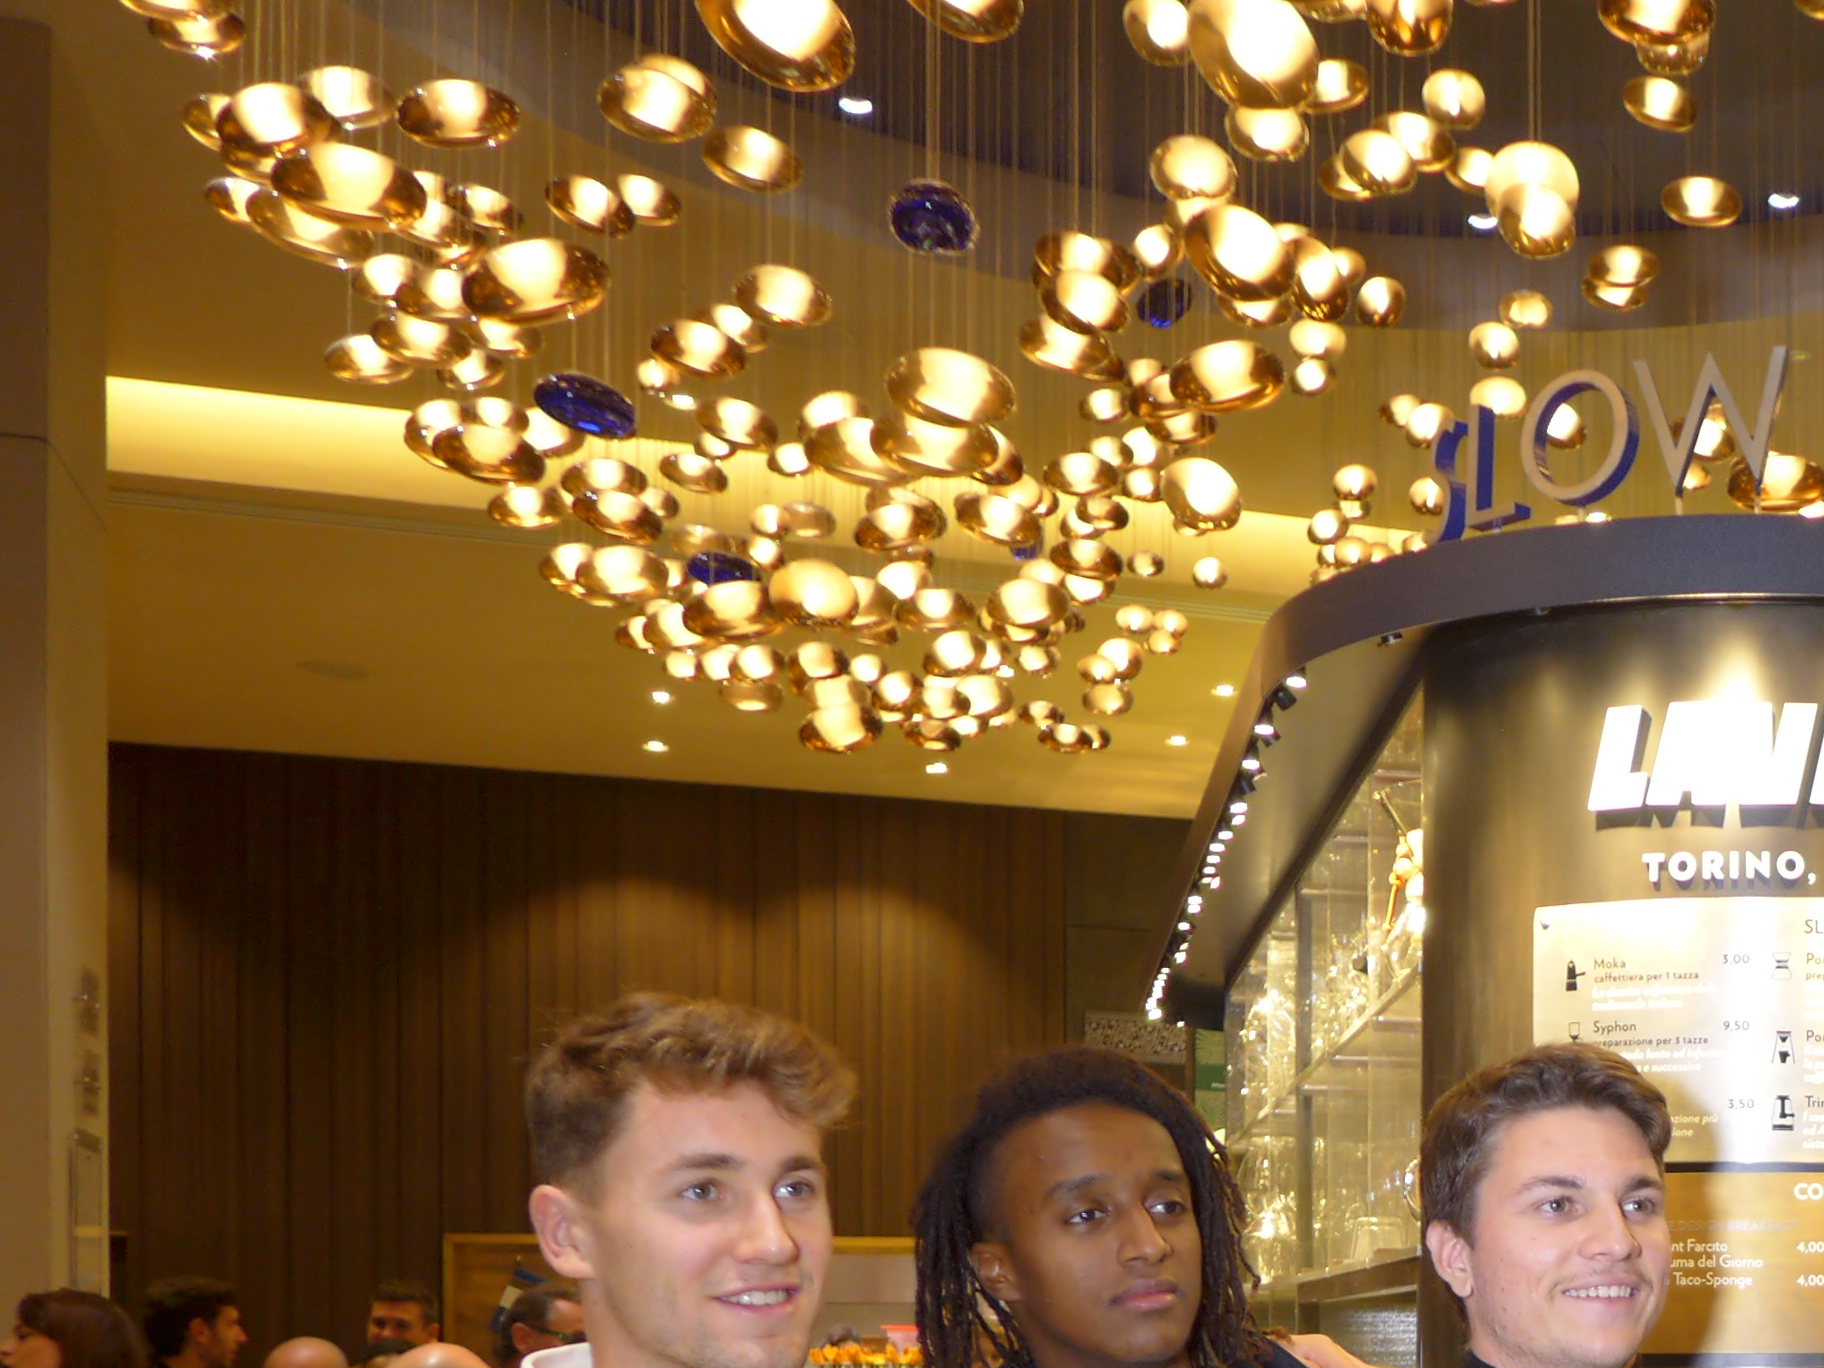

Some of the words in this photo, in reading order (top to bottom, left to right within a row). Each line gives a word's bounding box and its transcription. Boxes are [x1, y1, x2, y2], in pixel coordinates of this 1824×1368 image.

[1430, 344, 1789, 544] SLOW
[1642, 850, 1816, 886] TORINO,
[1593, 957, 1626, 970] Moka
[1721, 954, 1750, 965] 3,00
[1594, 971, 1644, 984] caffettiera
[1646, 974, 1663, 983] per
[1673, 972, 1700, 980] tazza
[1593, 1020, 1637, 1035] Syphon
[1723, 1020, 1750, 1032] 9,50
[1656, 1038, 1672, 1047] per
[1683, 1035, 1709, 1045] tazze
[1728, 1098, 1755, 1110] 3,50
[1727, 1220, 1797, 1232] BREAKFAST
[1686, 1238, 1729, 1253] Farcito
[1697, 1254, 1716, 1268] del
[1719, 1254, 1763, 1269] Giorno
[1673, 1271, 1753, 1289] Taco-Sponge
